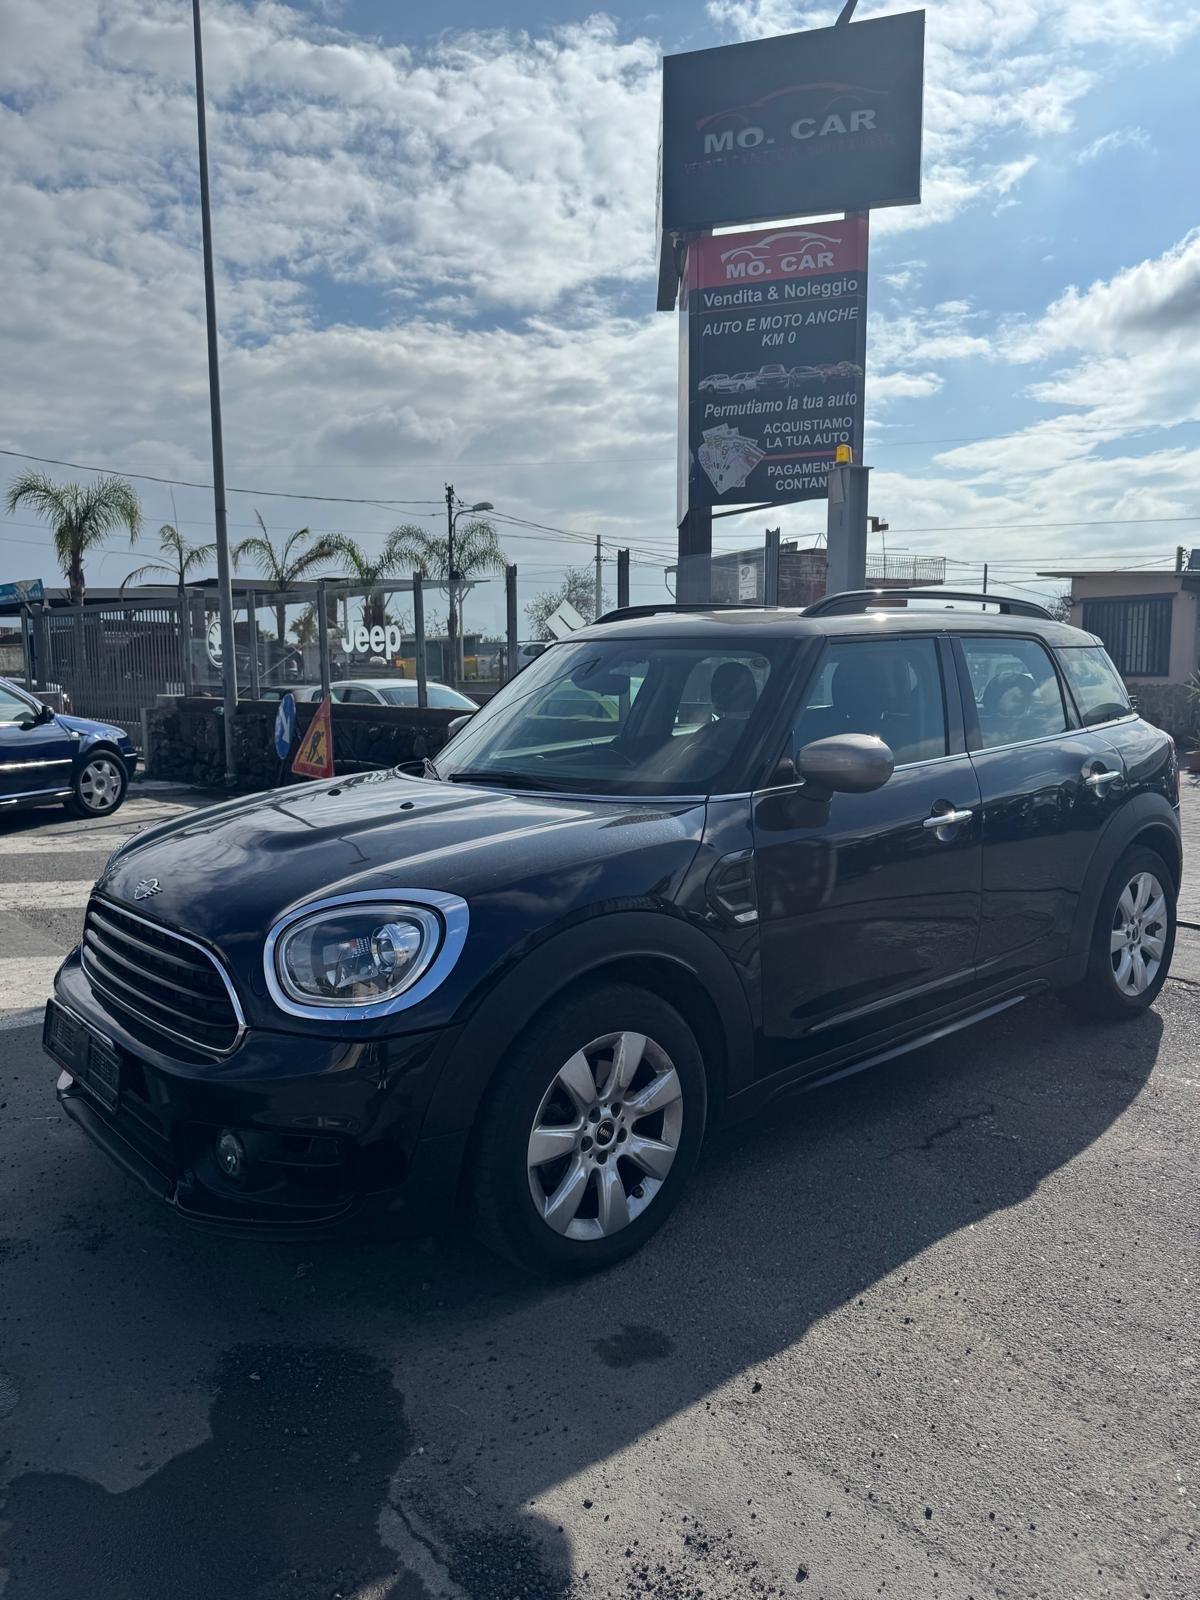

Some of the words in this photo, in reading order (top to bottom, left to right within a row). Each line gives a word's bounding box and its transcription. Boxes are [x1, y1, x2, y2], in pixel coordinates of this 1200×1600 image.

[704, 127, 775, 154] MO.
[790, 109, 877, 140] CAR
[726, 260, 772, 279] MO.
[780, 252, 834, 272] CAR
[703, 289, 762, 307] Vendita
[767, 286, 779, 300] &
[784, 278, 858, 298] Noleggio
[702, 320, 742, 336] AUTO
[746, 318, 756, 331] E
[759, 314, 802, 330] MOTO
[805, 307, 859, 325] ANCHE
[762, 333, 784, 346] KM
[704, 400, 783, 418] Permutiamo
[787, 396, 798, 410] la
[802, 395, 824, 409] tua
[828, 392, 857, 406] auto
[763, 417, 852, 434] ACQUISTIAMO
[767, 438, 783, 448] LA
[786, 435, 811, 446] TUA
[814, 432, 849, 444] AUTO
[768, 462, 836, 476] PAGAMENT
[776, 476, 827, 490] CONTAN
[341, 622, 401, 660] Jeep
